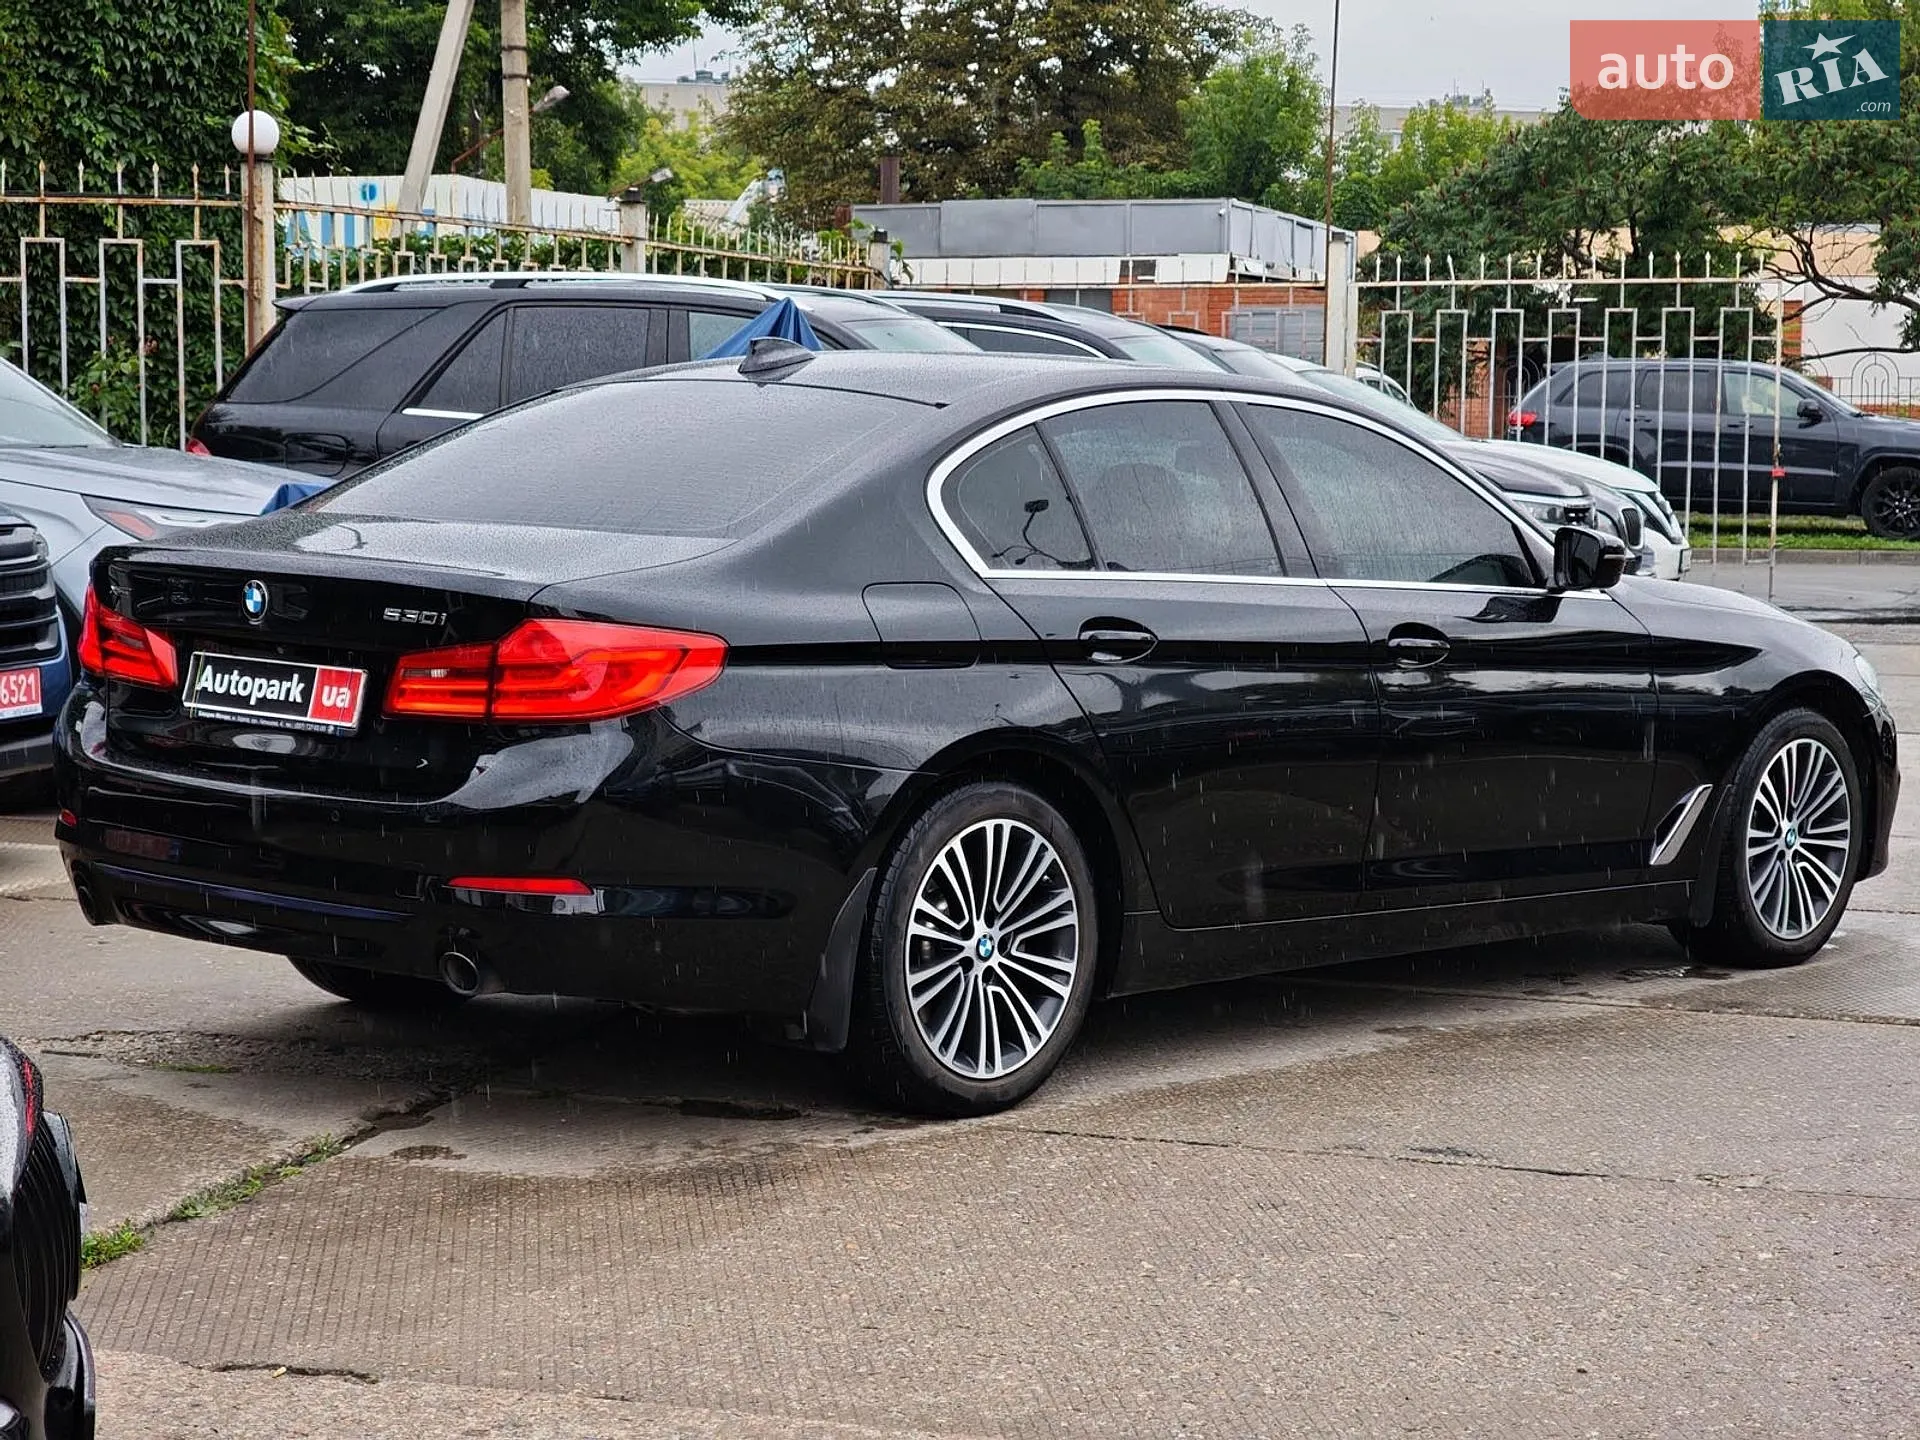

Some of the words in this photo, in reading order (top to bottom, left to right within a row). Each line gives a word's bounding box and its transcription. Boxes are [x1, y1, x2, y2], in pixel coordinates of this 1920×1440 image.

[383, 608, 447, 625] 530i
[197, 665, 305, 706] Autopark
[321, 685, 351, 708] ua
